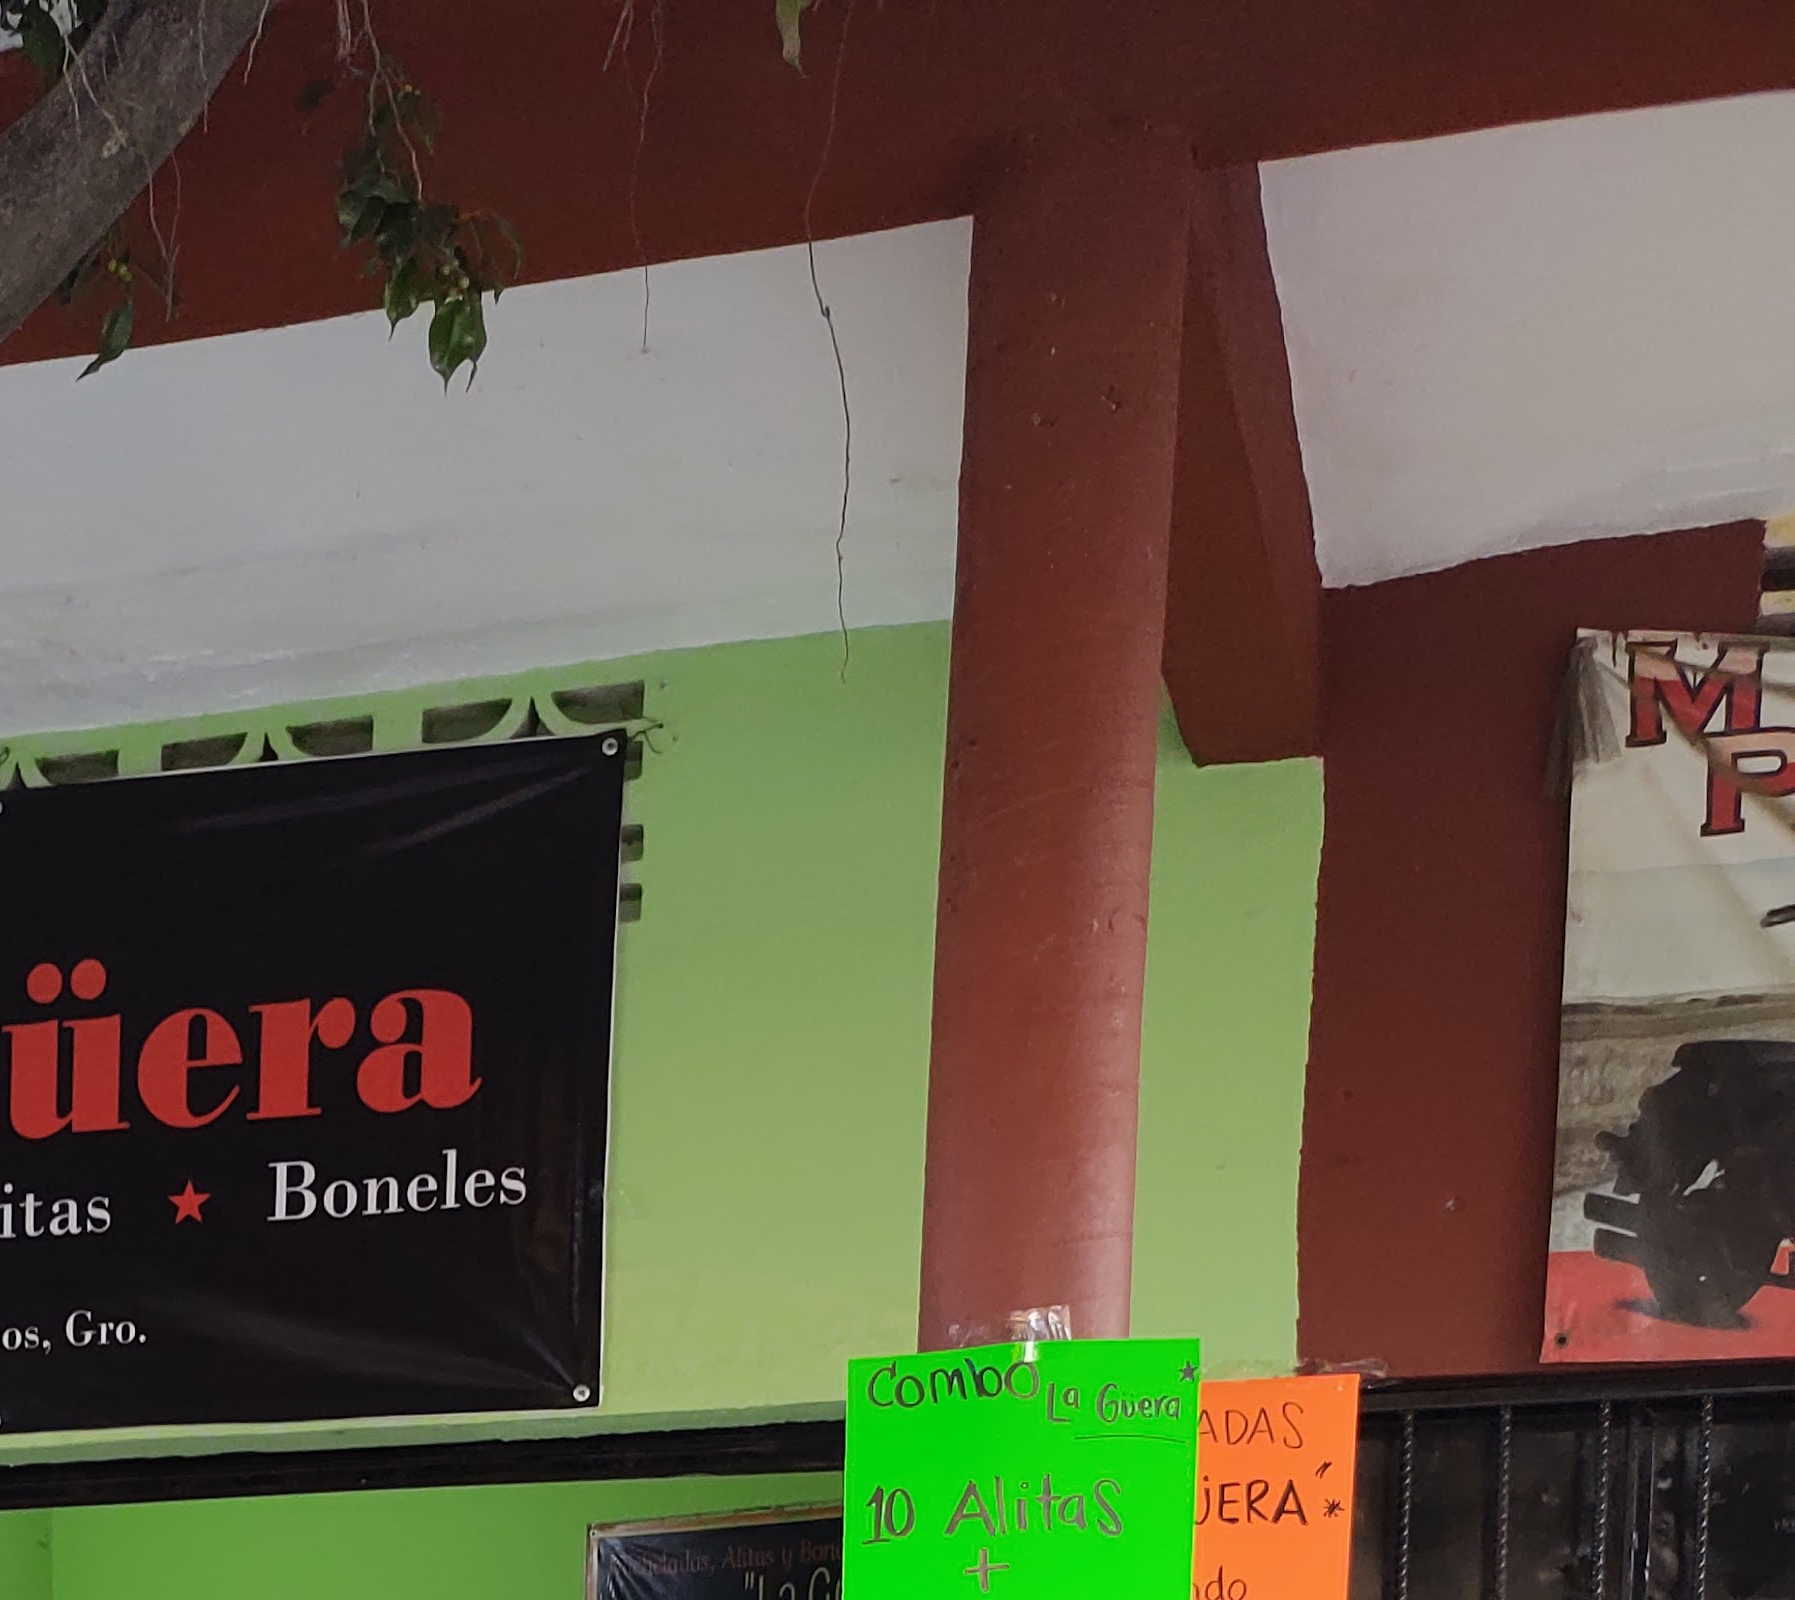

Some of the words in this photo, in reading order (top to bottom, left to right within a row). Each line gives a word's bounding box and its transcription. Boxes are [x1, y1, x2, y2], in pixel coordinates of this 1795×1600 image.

[266, 1149, 527, 1223] Boneles
[65, 1310, 147, 1348] Gro.
[1047, 1383, 1080, 1423] La
[862, 1485, 915, 1545] 10
